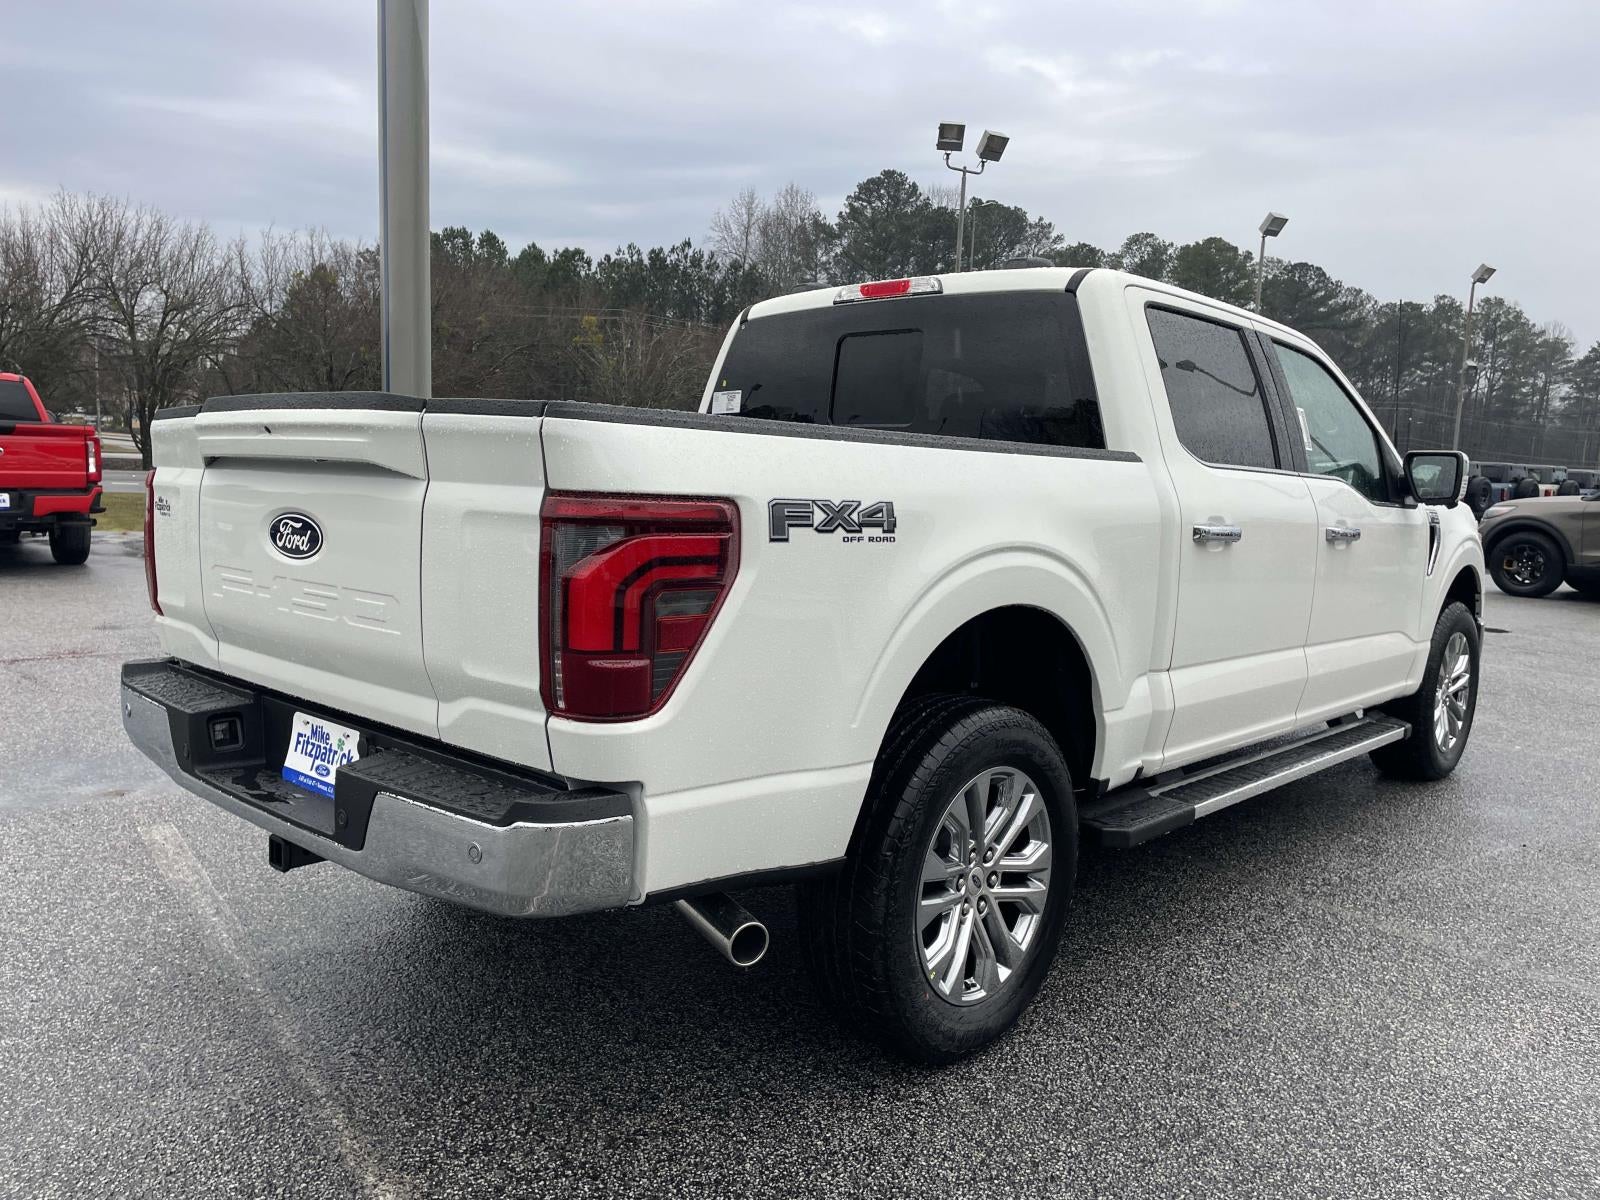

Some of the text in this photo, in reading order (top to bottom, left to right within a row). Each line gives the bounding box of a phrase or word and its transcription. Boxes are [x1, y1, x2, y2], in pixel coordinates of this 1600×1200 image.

[276, 519, 312, 551] Ford
[768, 498, 896, 543] FX4
[294, 732, 354, 771] Fitzpatrick
[310, 723, 331, 746] Mike
